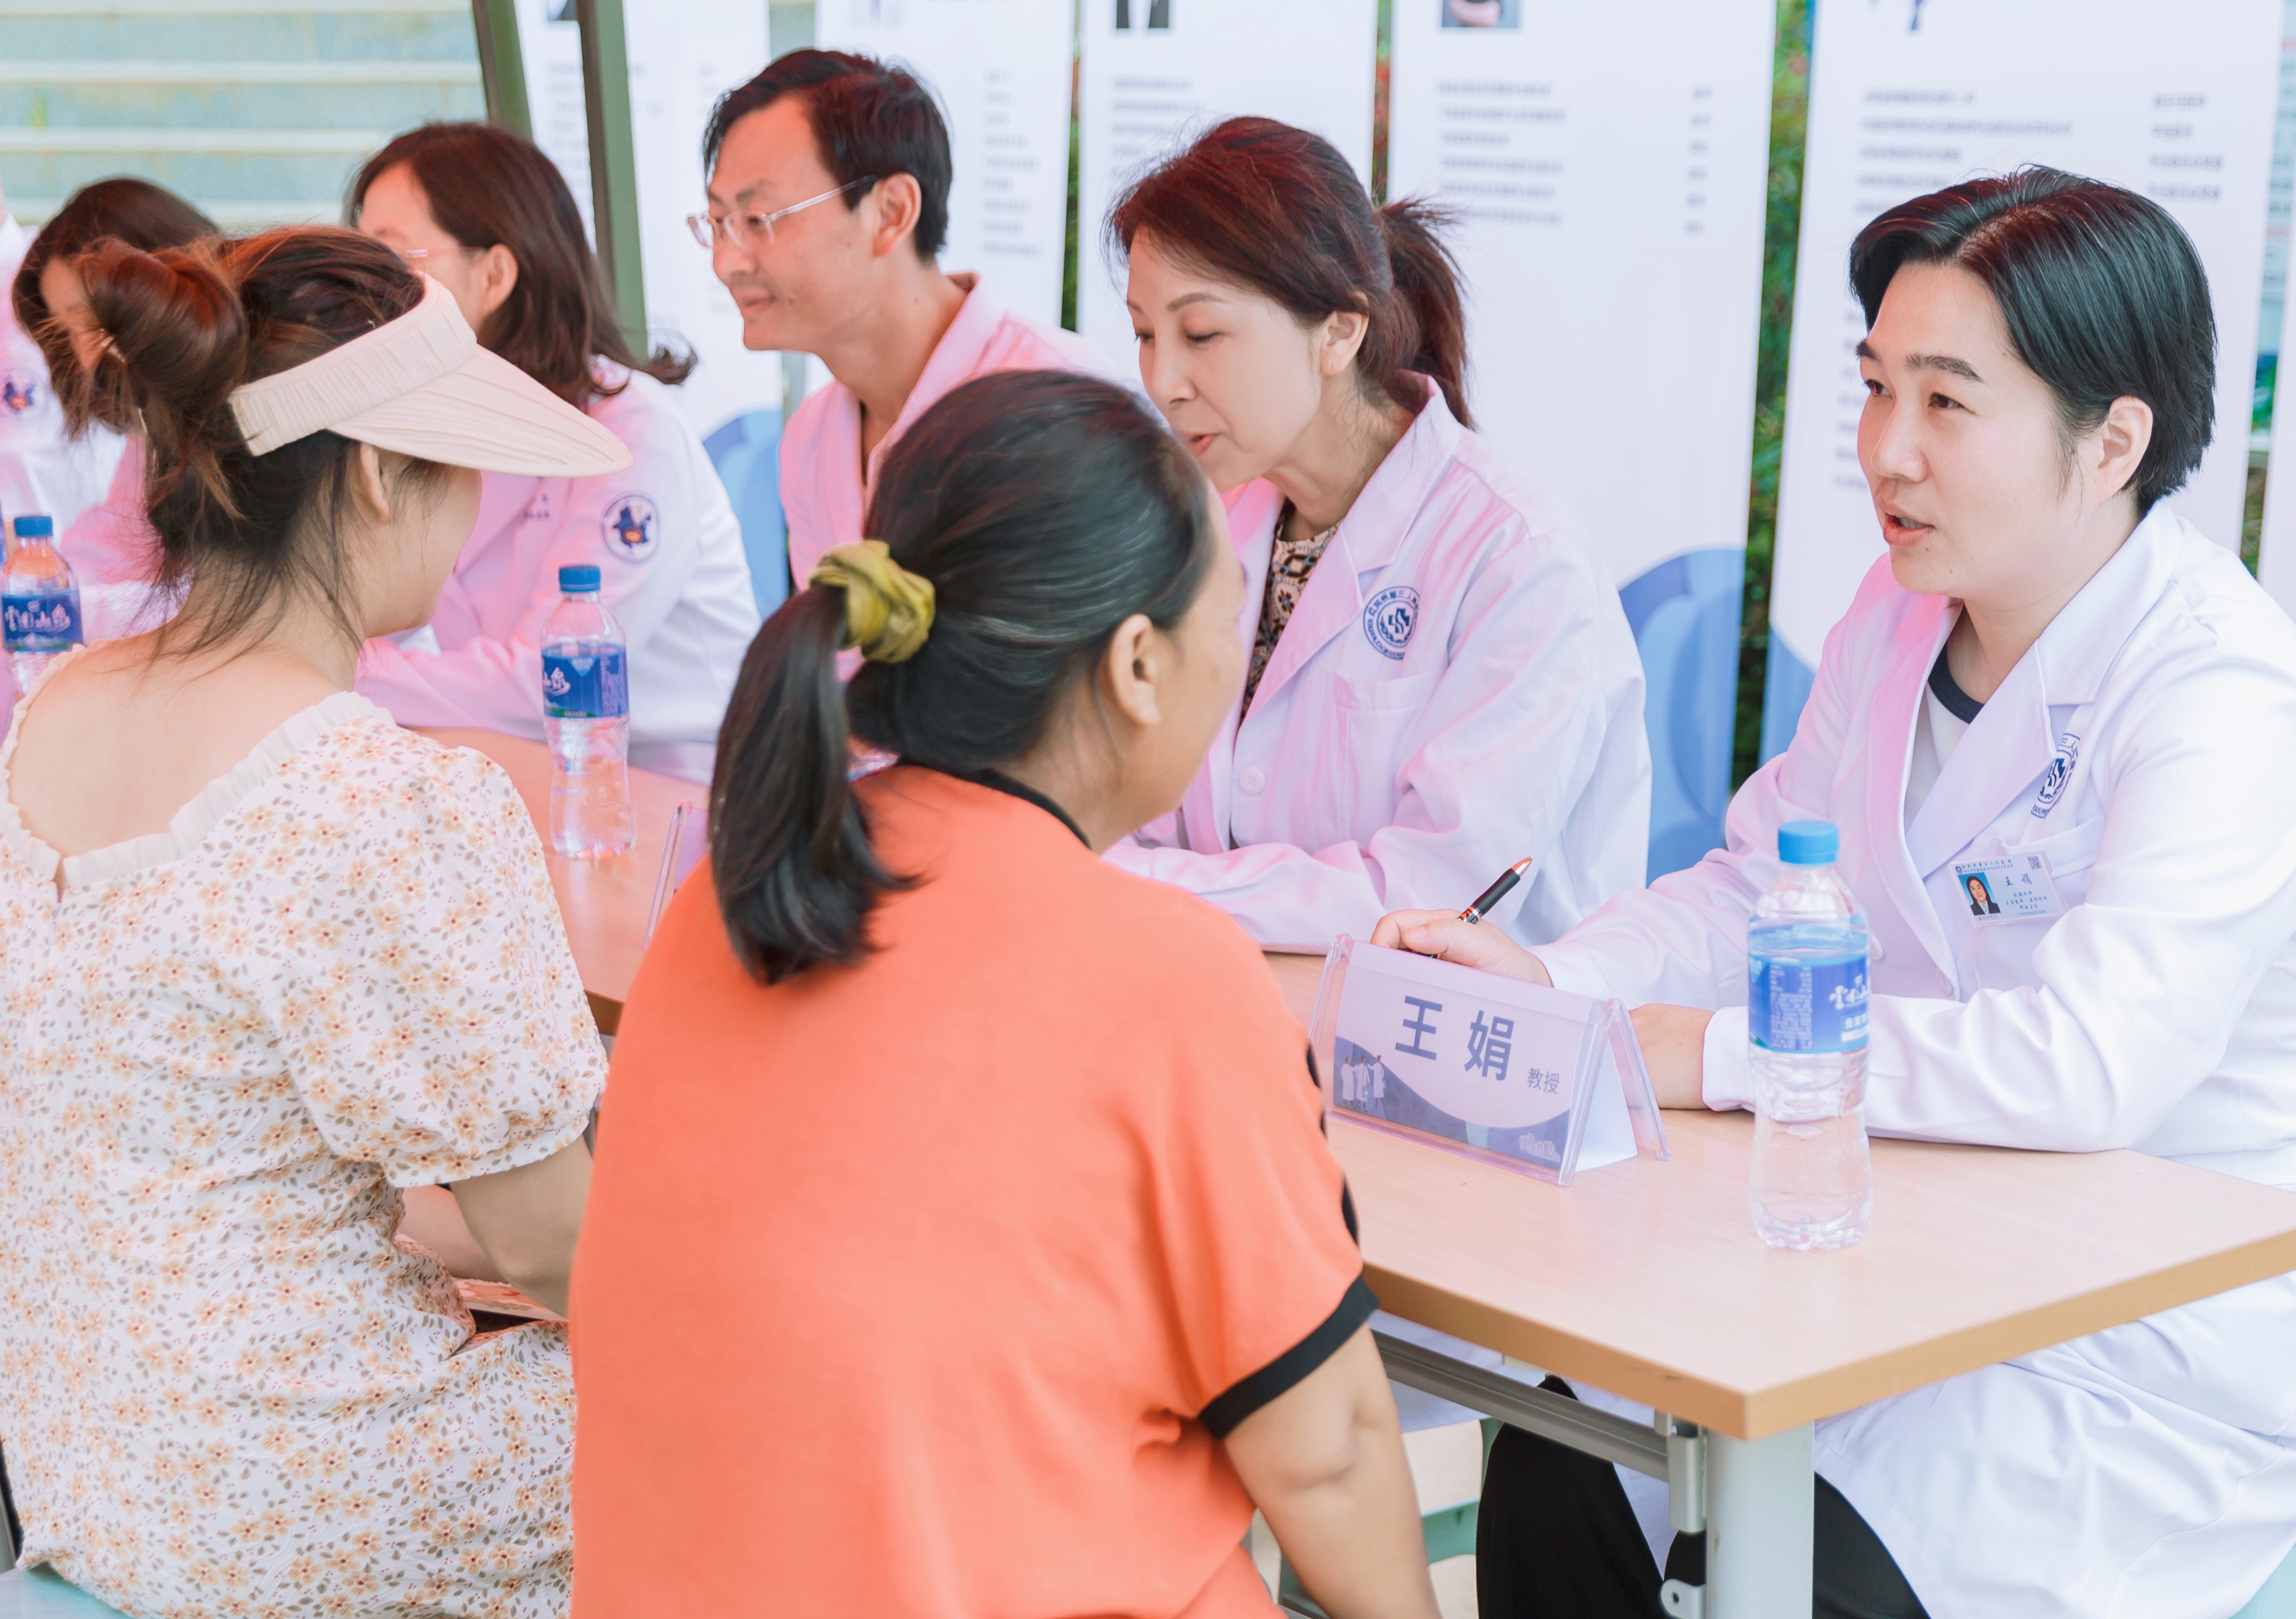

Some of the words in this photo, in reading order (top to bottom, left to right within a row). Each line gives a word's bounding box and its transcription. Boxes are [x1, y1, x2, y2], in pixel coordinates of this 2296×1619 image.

[1395, 994, 1443, 1061] 王
[1464, 1010, 1515, 1081] 娟
[1527, 1066, 1561, 1095] 教授
